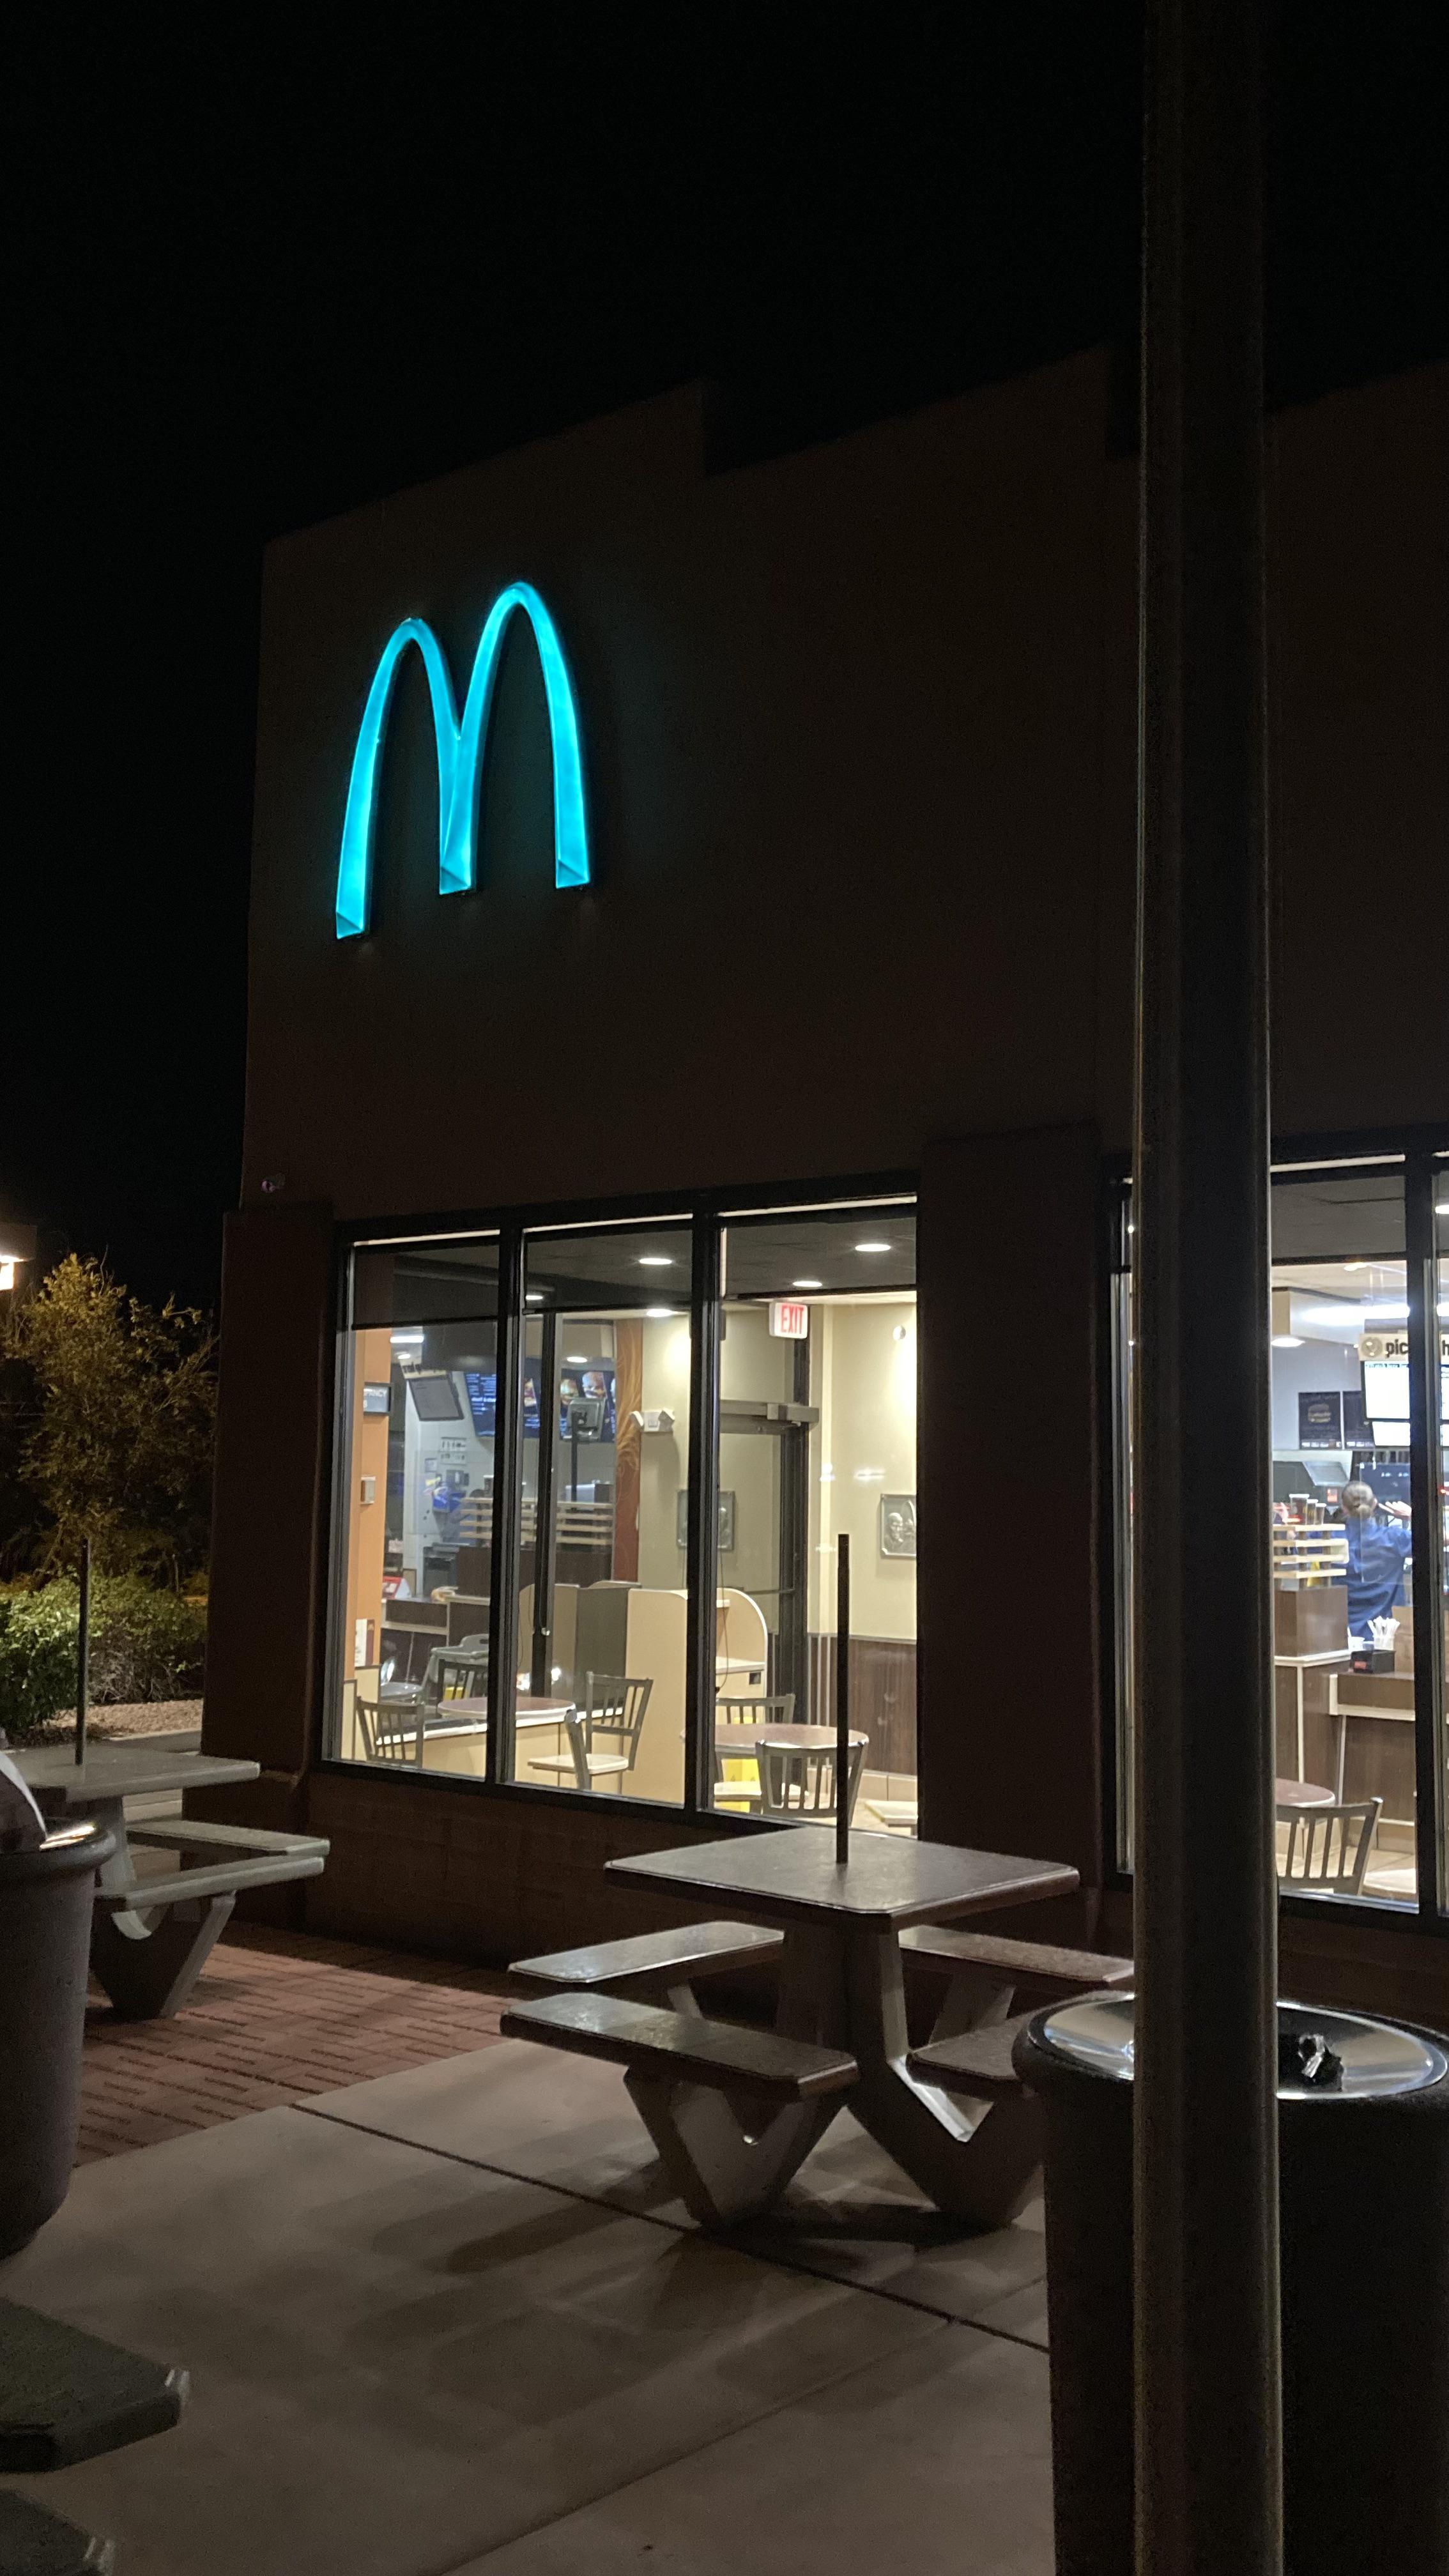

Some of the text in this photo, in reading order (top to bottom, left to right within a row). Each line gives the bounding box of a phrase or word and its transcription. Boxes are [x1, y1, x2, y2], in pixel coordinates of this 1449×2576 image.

[335, 581, 590, 940] M
[781, 1305, 804, 1334] EXIT
[1385, 1338, 1409, 1358] pic
